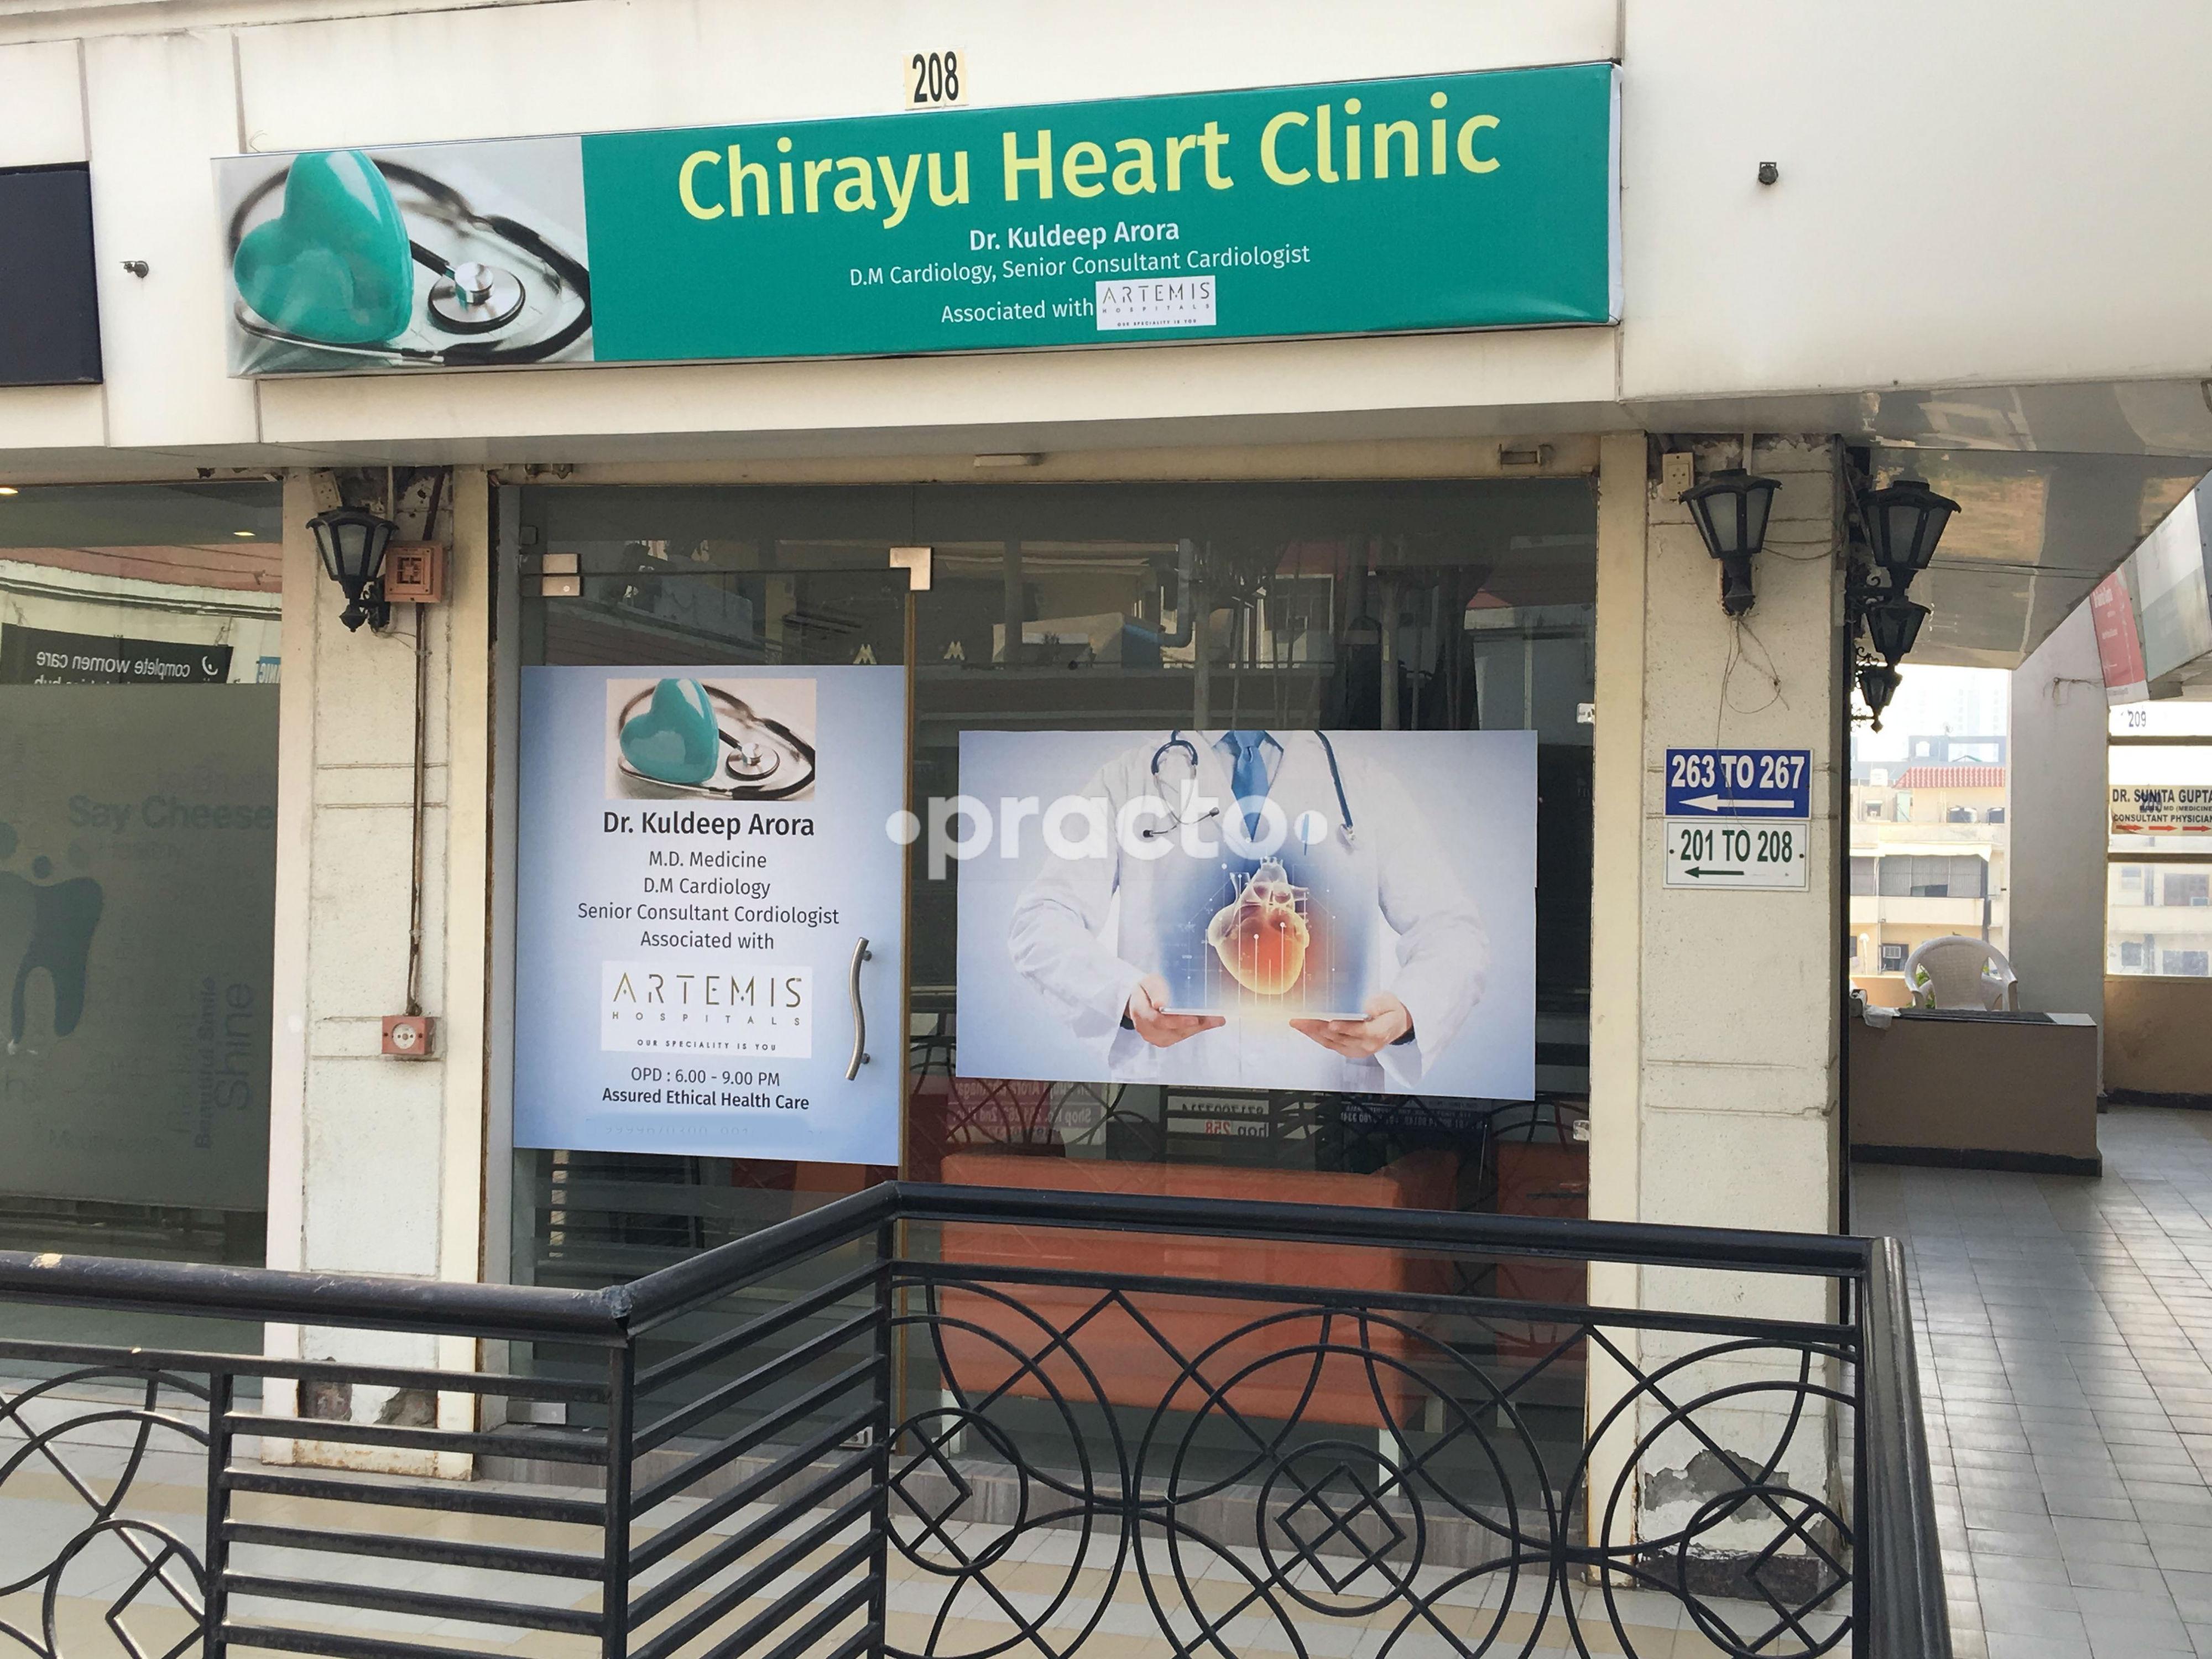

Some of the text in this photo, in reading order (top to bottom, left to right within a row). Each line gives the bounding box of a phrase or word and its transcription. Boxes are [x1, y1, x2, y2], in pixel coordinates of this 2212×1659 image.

[912, 51, 959, 103] 208
[679, 91, 1500, 229] Chirayu Heart Clinic
[970, 221, 1180, 251] Dr. Kuldeep Arora
[850, 243, 1311, 286] D.M Cardiology, Senior Consultant Cardiologist
[1102, 281, 1210, 304] ARTEMIS
[941, 298, 1094, 323] Associated with
[1102, 304, 1209, 314] HOSPITALS
[2127, 710, 2146, 727] 209
[1671, 754, 1805, 789] 263 TO 267
[2112, 789, 2130, 802] DR.
[2134, 789, 2175, 802] SUNITA
[604, 811, 814, 841] Dr. Kuldeep Arora
[2114, 814, 2168, 822] CONSULTANT
[1680, 829, 1792, 863] 201 TO 208
[649, 850, 766, 868] M.D. Medicine
[644, 877, 771, 899] D.M Cardiology
[578, 901, 839, 928] Senior Consultant Cordiologist
[640, 930, 774, 950] Associated with
[613, 972, 802, 1008] ARTEMIS
[612, 1011, 800, 1026] HOSPITALS
[665, 1040, 729, 1049] SPECIALITY
[631, 1067, 662, 1082] OPD
[675, 1069, 706, 1084] 6.00
[722, 1071, 753, 1086] 9.00
[758, 1072, 780, 1087] PM
[602, 1087, 810, 1110] Assured Ethical Health Care
